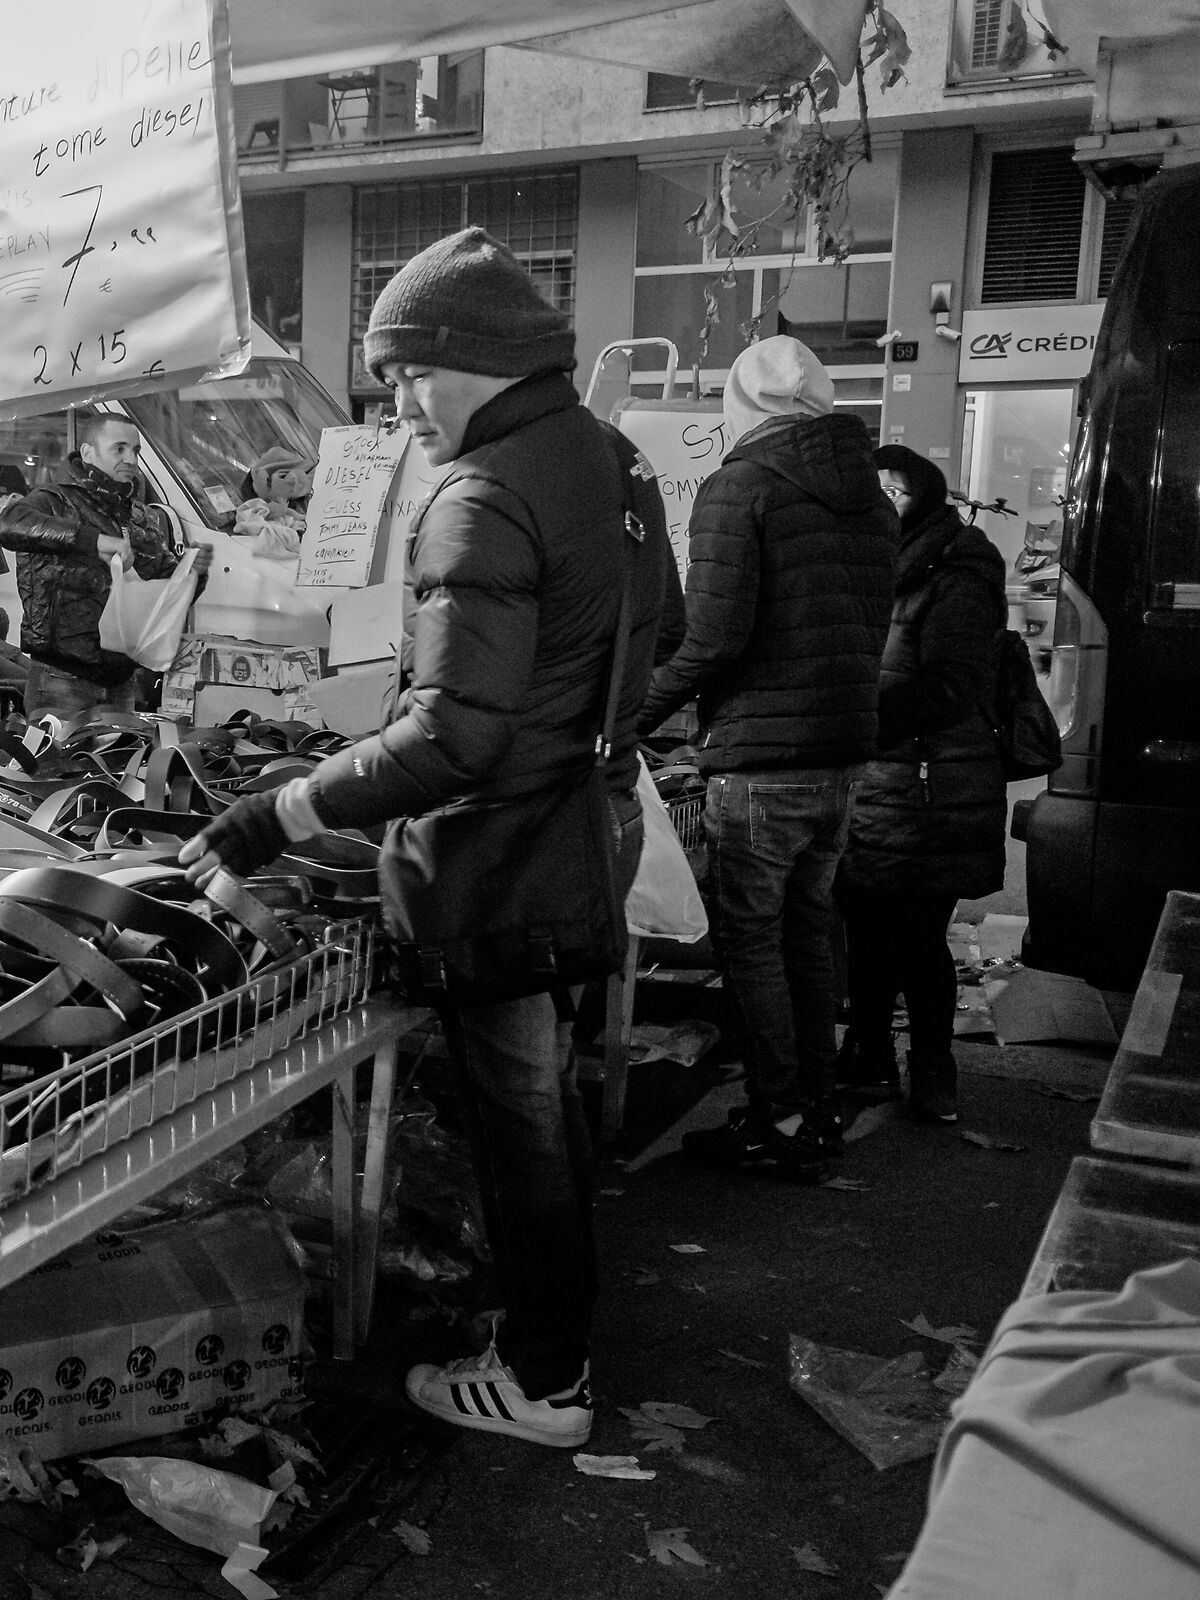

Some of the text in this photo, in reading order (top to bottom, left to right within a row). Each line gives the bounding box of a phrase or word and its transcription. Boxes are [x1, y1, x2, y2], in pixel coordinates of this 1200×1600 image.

[33, 346, 52, 385] 2
[99, 330, 128, 364] 15
[896, 344, 914, 360] 59
[682, 422, 731, 459] ST
[325, 466, 370, 486] DIESEL
[322, 499, 362, 514] GUESS
[97, 1246, 141, 1262] GEODIS
[255, 1357, 291, 1370] GEODI
[188, 1367, 224, 1382] GEODI
[119, 1379, 157, 1394] GEODI
[49, 1393, 86, 1406] GEODI
[148, 1401, 190, 1416] GEODIS
[78, 1412, 122, 1426] GEODIS
